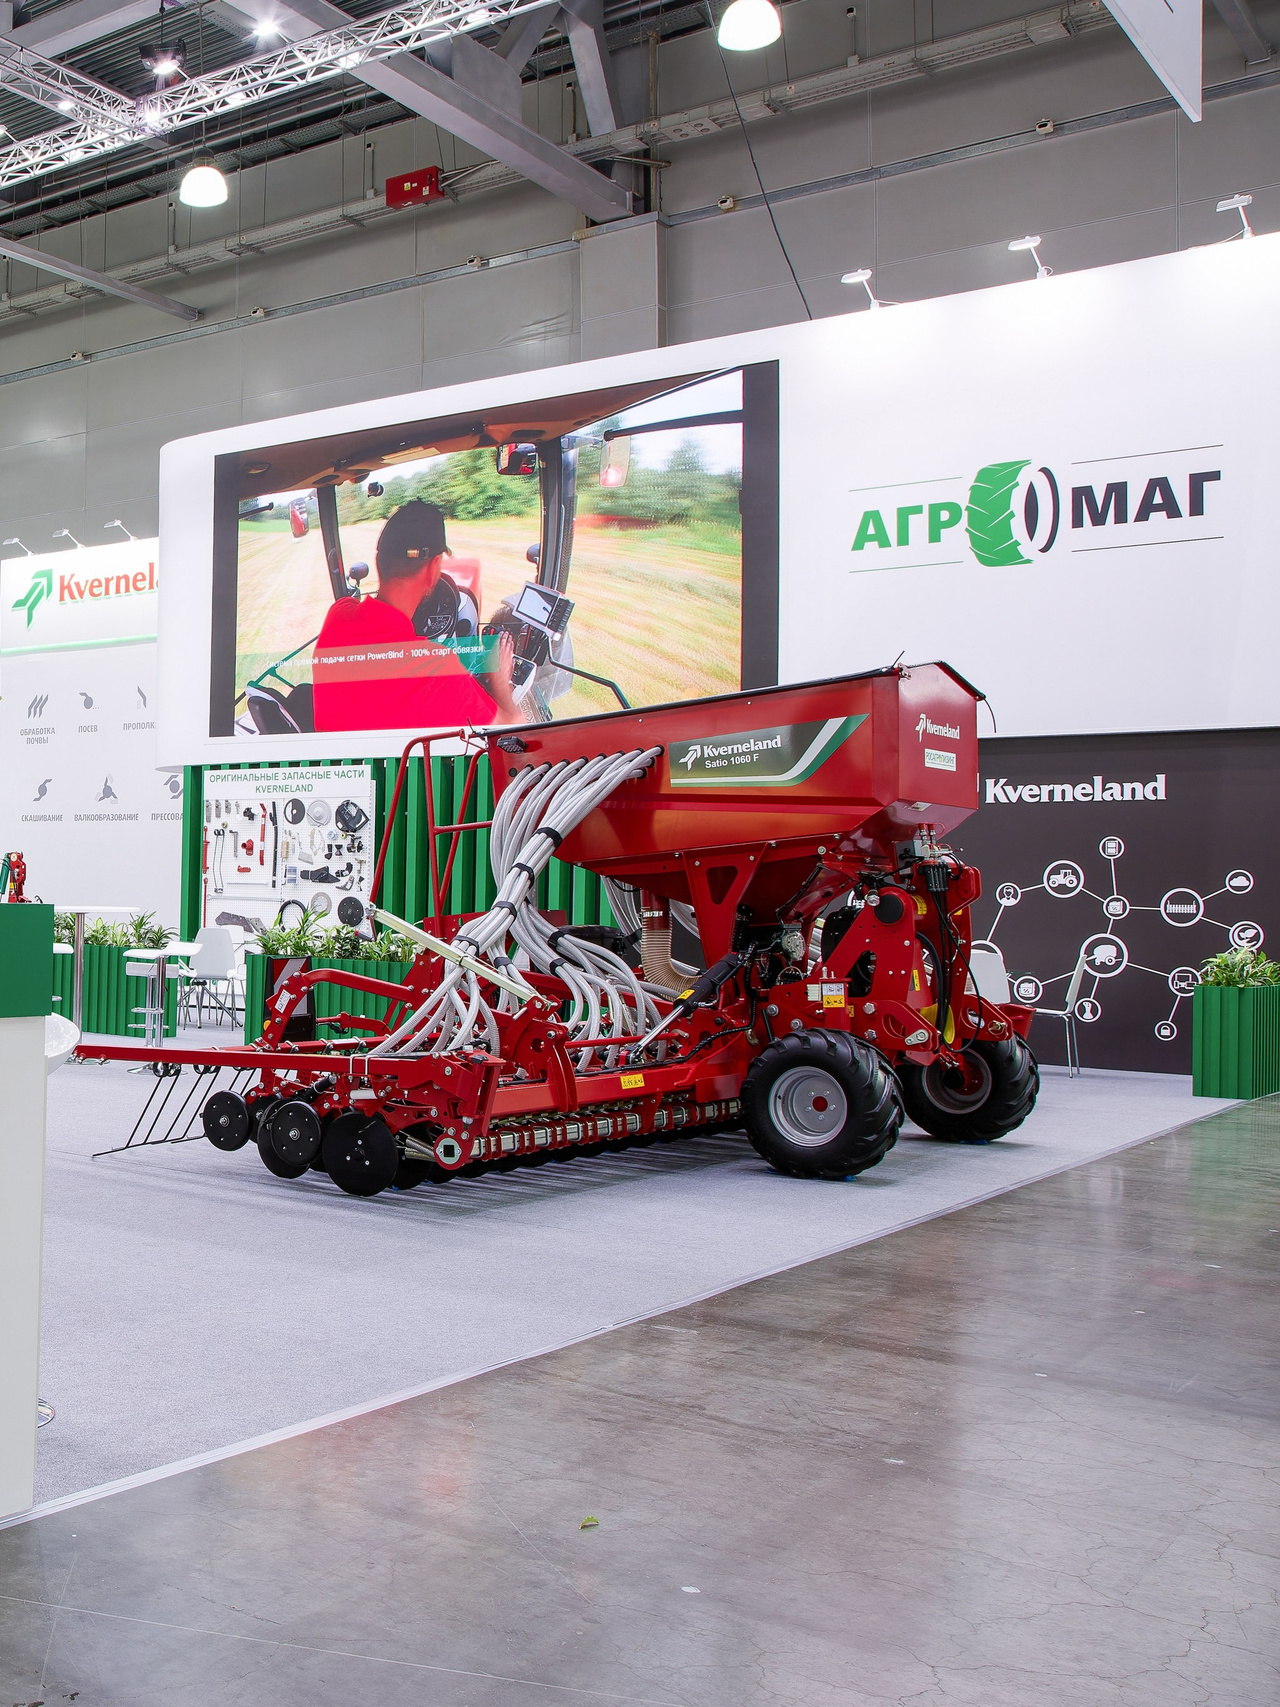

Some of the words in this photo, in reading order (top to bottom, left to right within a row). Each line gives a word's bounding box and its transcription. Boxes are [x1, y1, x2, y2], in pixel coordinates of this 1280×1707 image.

[58, 562, 158, 602] Kvernel
[320, 656, 346, 665] подачи
[346, 653, 366, 662] сетки
[367, 649, 404, 660] PowerBind
[410, 648, 430, 657] 100%
[431, 647, 451, 657] старт
[452, 645, 484, 655] обвязки
[19, 727, 56, 736] ОБРАБОТКА
[78, 725, 99, 734] ПОСЕВ
[122, 722, 156, 731] ПРОПОЛК
[926, 718, 960, 740] Kverneland
[26, 736, 49, 745] ПОЧВЫ
[703, 734, 782, 758] Kverneland
[705, 758, 729, 769] Satio
[729, 754, 751, 765] 1060
[753, 753, 760, 762] F
[209, 772, 280, 783] ОРИГИНАЛЬНЫЕ
[281, 770, 332, 781] ЗАПАСНЫЕ
[333, 769, 365, 779] ЧАСТИ
[255, 783, 314, 794] KVERNELAND
[984, 773, 1167, 804] Kverneland
[21, 814, 64, 822] СКАШИВАНИЕ
[74, 813, 139, 822] ВАЛКООБРАЗОВАНИЕ
